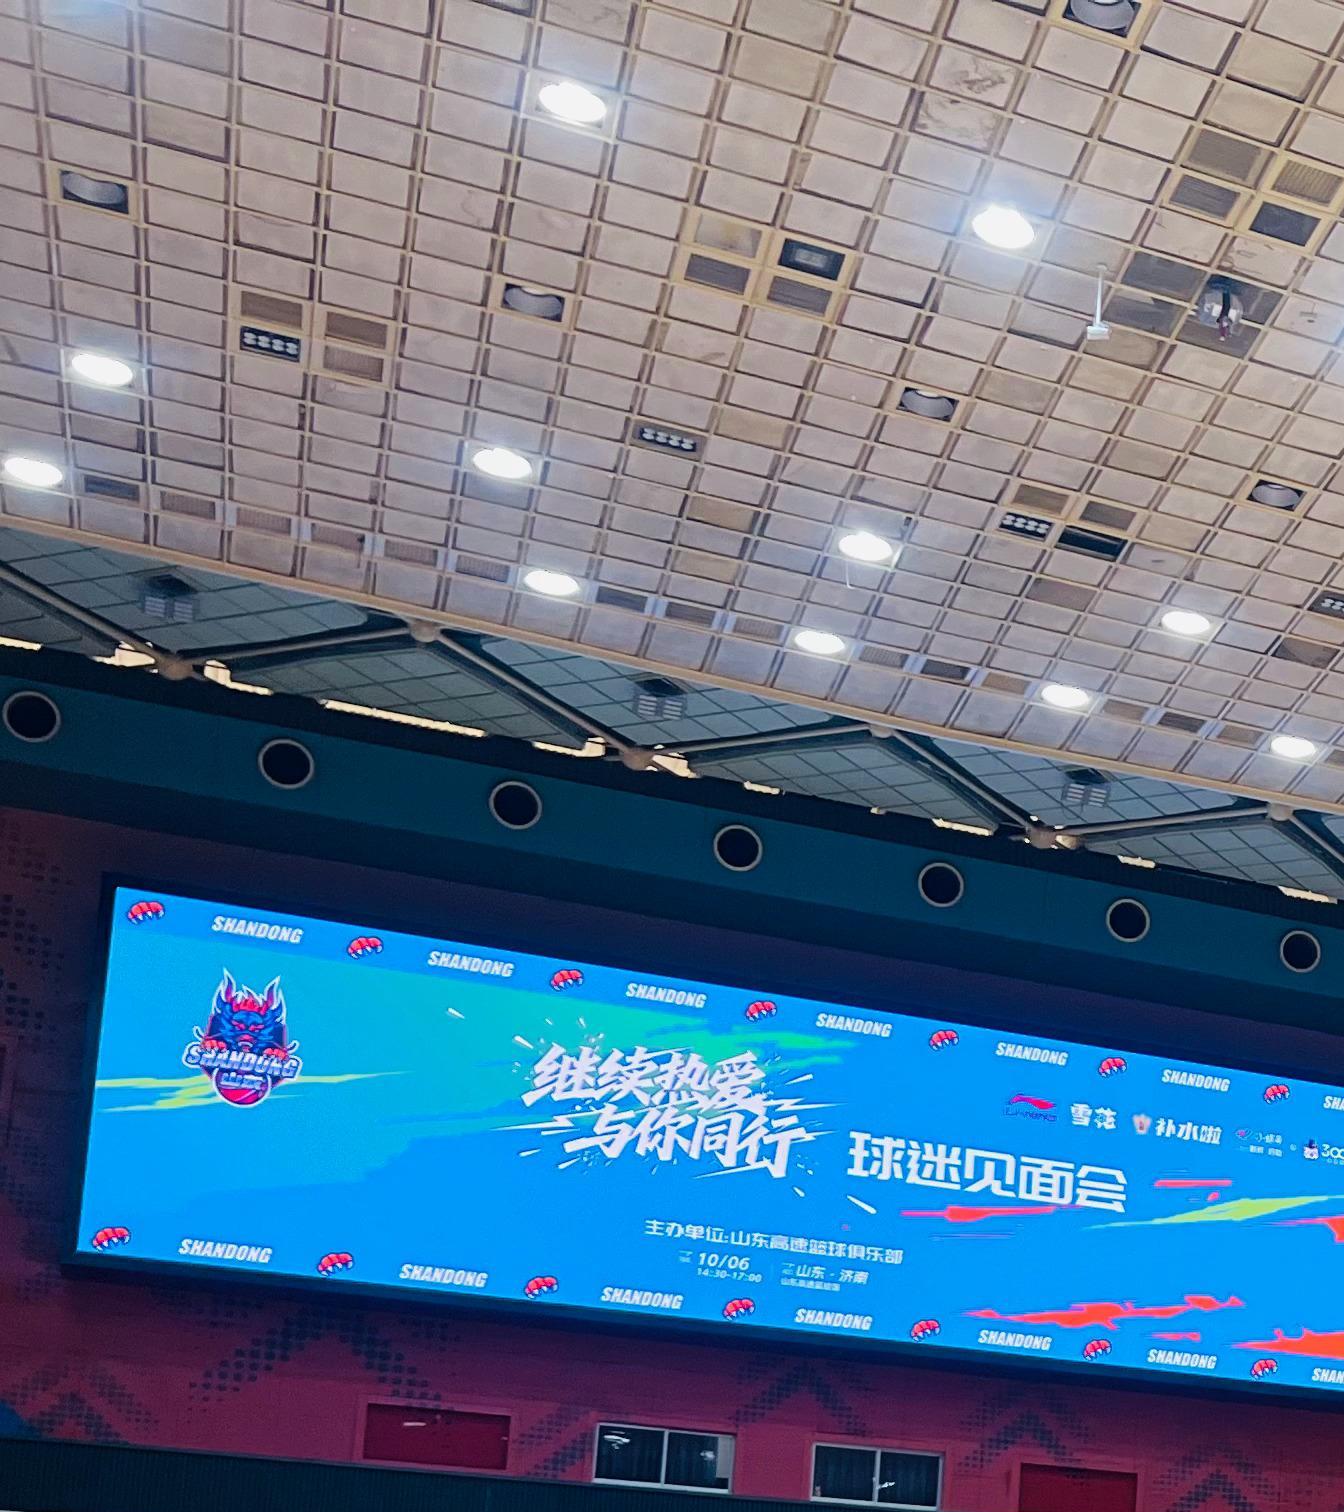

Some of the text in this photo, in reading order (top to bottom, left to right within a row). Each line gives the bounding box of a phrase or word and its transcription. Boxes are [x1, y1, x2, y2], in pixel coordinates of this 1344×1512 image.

[212, 915, 302, 944] SHANDONG
[427, 951, 514, 978] SHANDONG
[625, 982, 706, 1009] SHANDONG
[815, 1012, 892, 1038] SHANDONG
[996, 1042, 1068, 1067] SHANDONG
[1162, 1068, 1230, 1092] SHANDONG
[521, 1042, 768, 1115] 继续热爱
[563, 1104, 812, 1178] 与你同行
[1071, 1103, 1116, 1130] 雪花
[1155, 1117, 1221, 1145] 补水啦
[847, 1131, 1127, 1213] 球迷见面会
[698, 1252, 750, 1271] 10/06
[179, 1238, 272, 1265] SHANDONG
[399, 1263, 487, 1289] SHANDONG
[601, 1286, 683, 1311] SHANDONG
[795, 1307, 872, 1331] SHANDONG
[978, 1329, 1052, 1352] SHANDONG
[1147, 1349, 1217, 1370] SHANDONG
